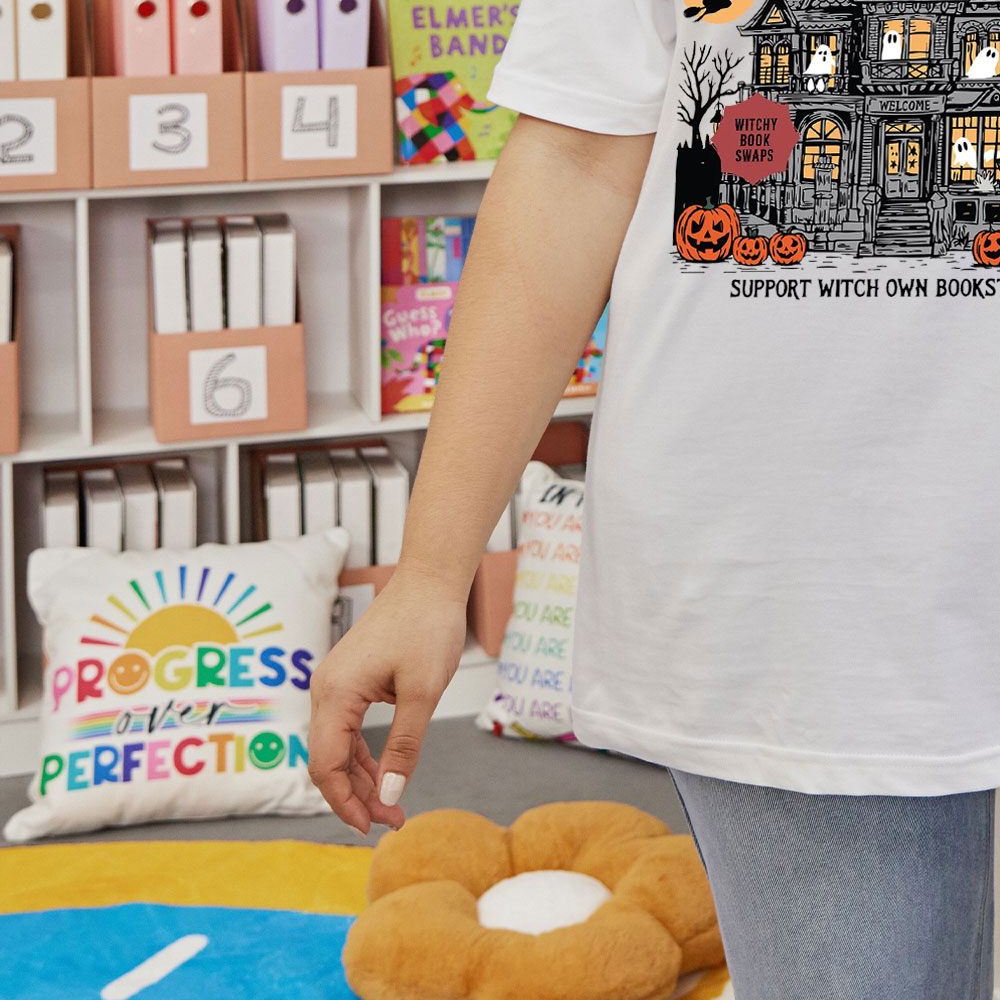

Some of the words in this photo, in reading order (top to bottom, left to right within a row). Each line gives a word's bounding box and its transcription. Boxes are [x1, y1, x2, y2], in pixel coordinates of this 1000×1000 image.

[430, 34, 508, 59] BAND
[880, 99, 931, 112] WELCOME
[152, 102, 192, 155] 3
[290, 95, 340, 148] 4
[735, 117, 778, 131] WITCHY
[0, 112, 35, 165] 2
[740, 133, 770, 147] BOOK
[735, 149, 774, 162] SWAPS
[730, 278, 812, 300] SUPPORT
[818, 278, 880, 298] WITCH
[886, 278, 928, 297] OWN
[383, 306, 438, 328] Guess
[388, 319, 443, 343] Who?
[203, 352, 253, 418] 6
[540, 604, 574, 630] ARE
[52, 646, 315, 713] PROGRESS
[115, 698, 256, 735] over
[40, 731, 310, 797] PERFECTION
